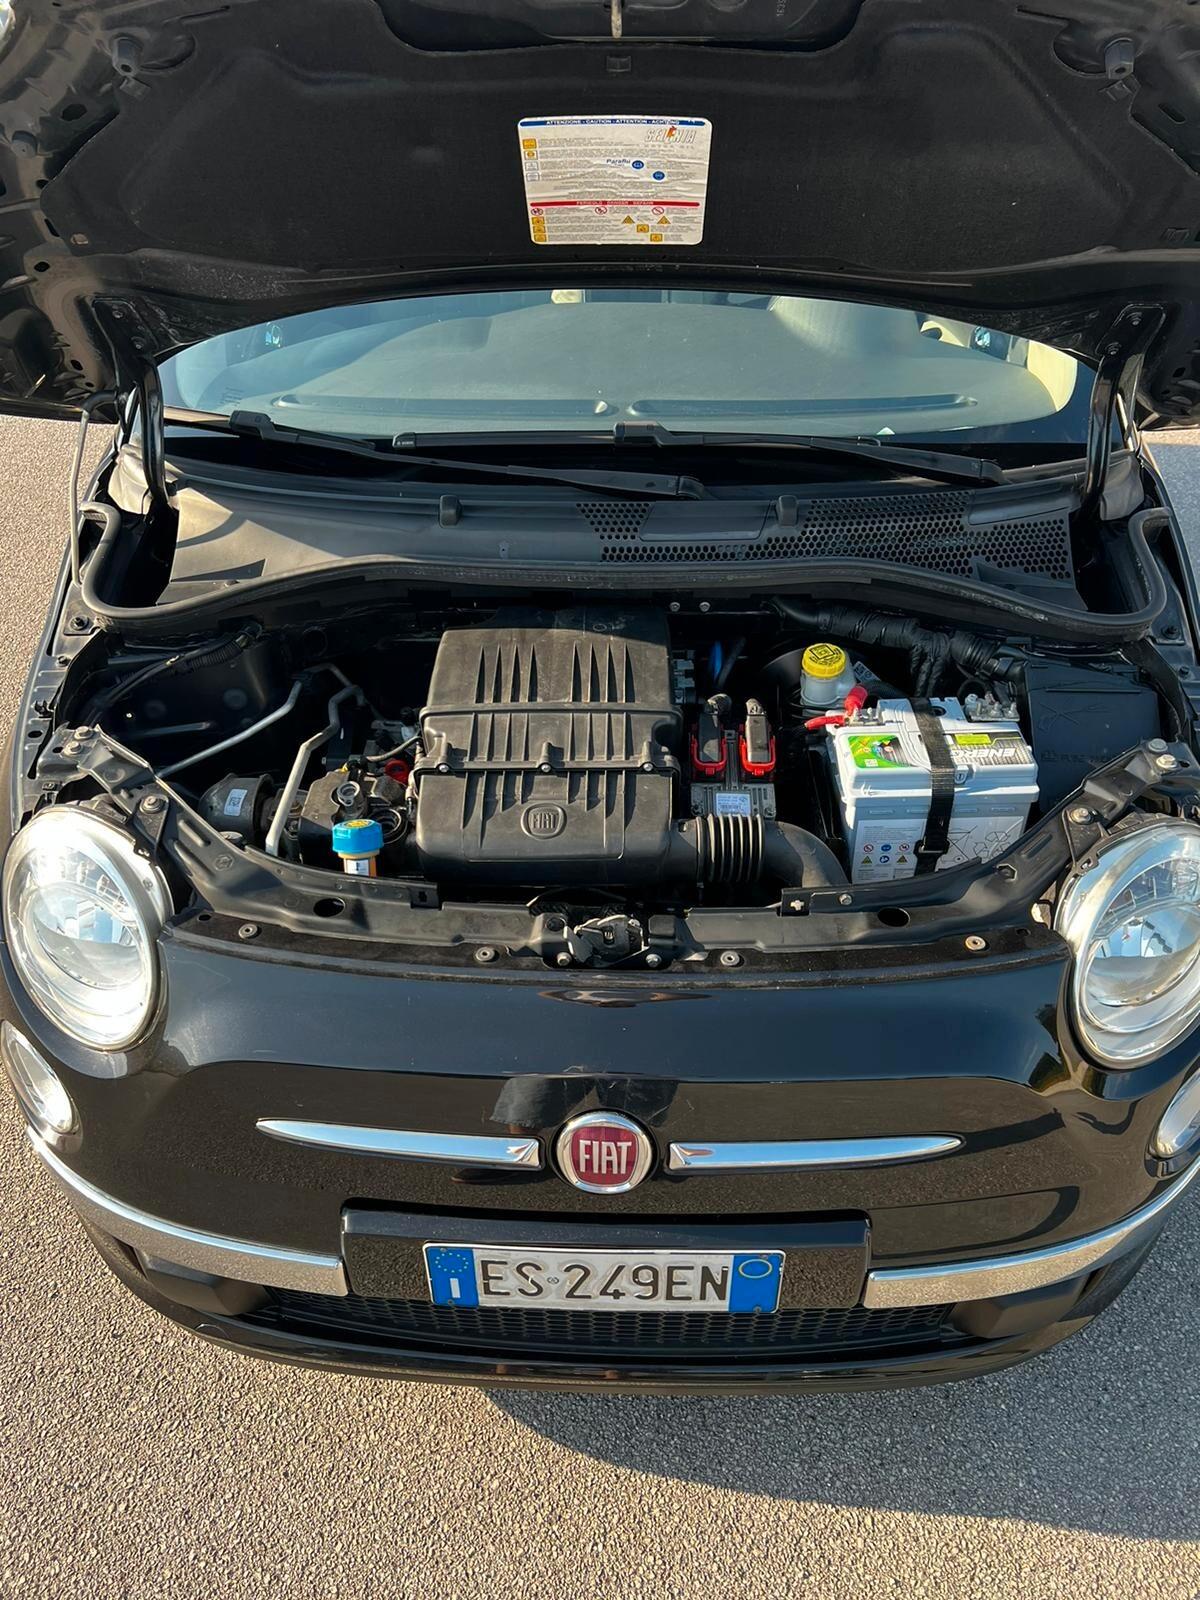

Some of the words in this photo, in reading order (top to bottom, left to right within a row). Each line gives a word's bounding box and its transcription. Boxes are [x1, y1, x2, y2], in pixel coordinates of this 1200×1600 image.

[950, 748, 1016, 758] ENERG
[531, 812, 559, 829] FIAT
[578, 1138, 633, 1175] FIAT
[480, 1259, 544, 1297] ES
[563, 1264, 729, 1301] 249EN
